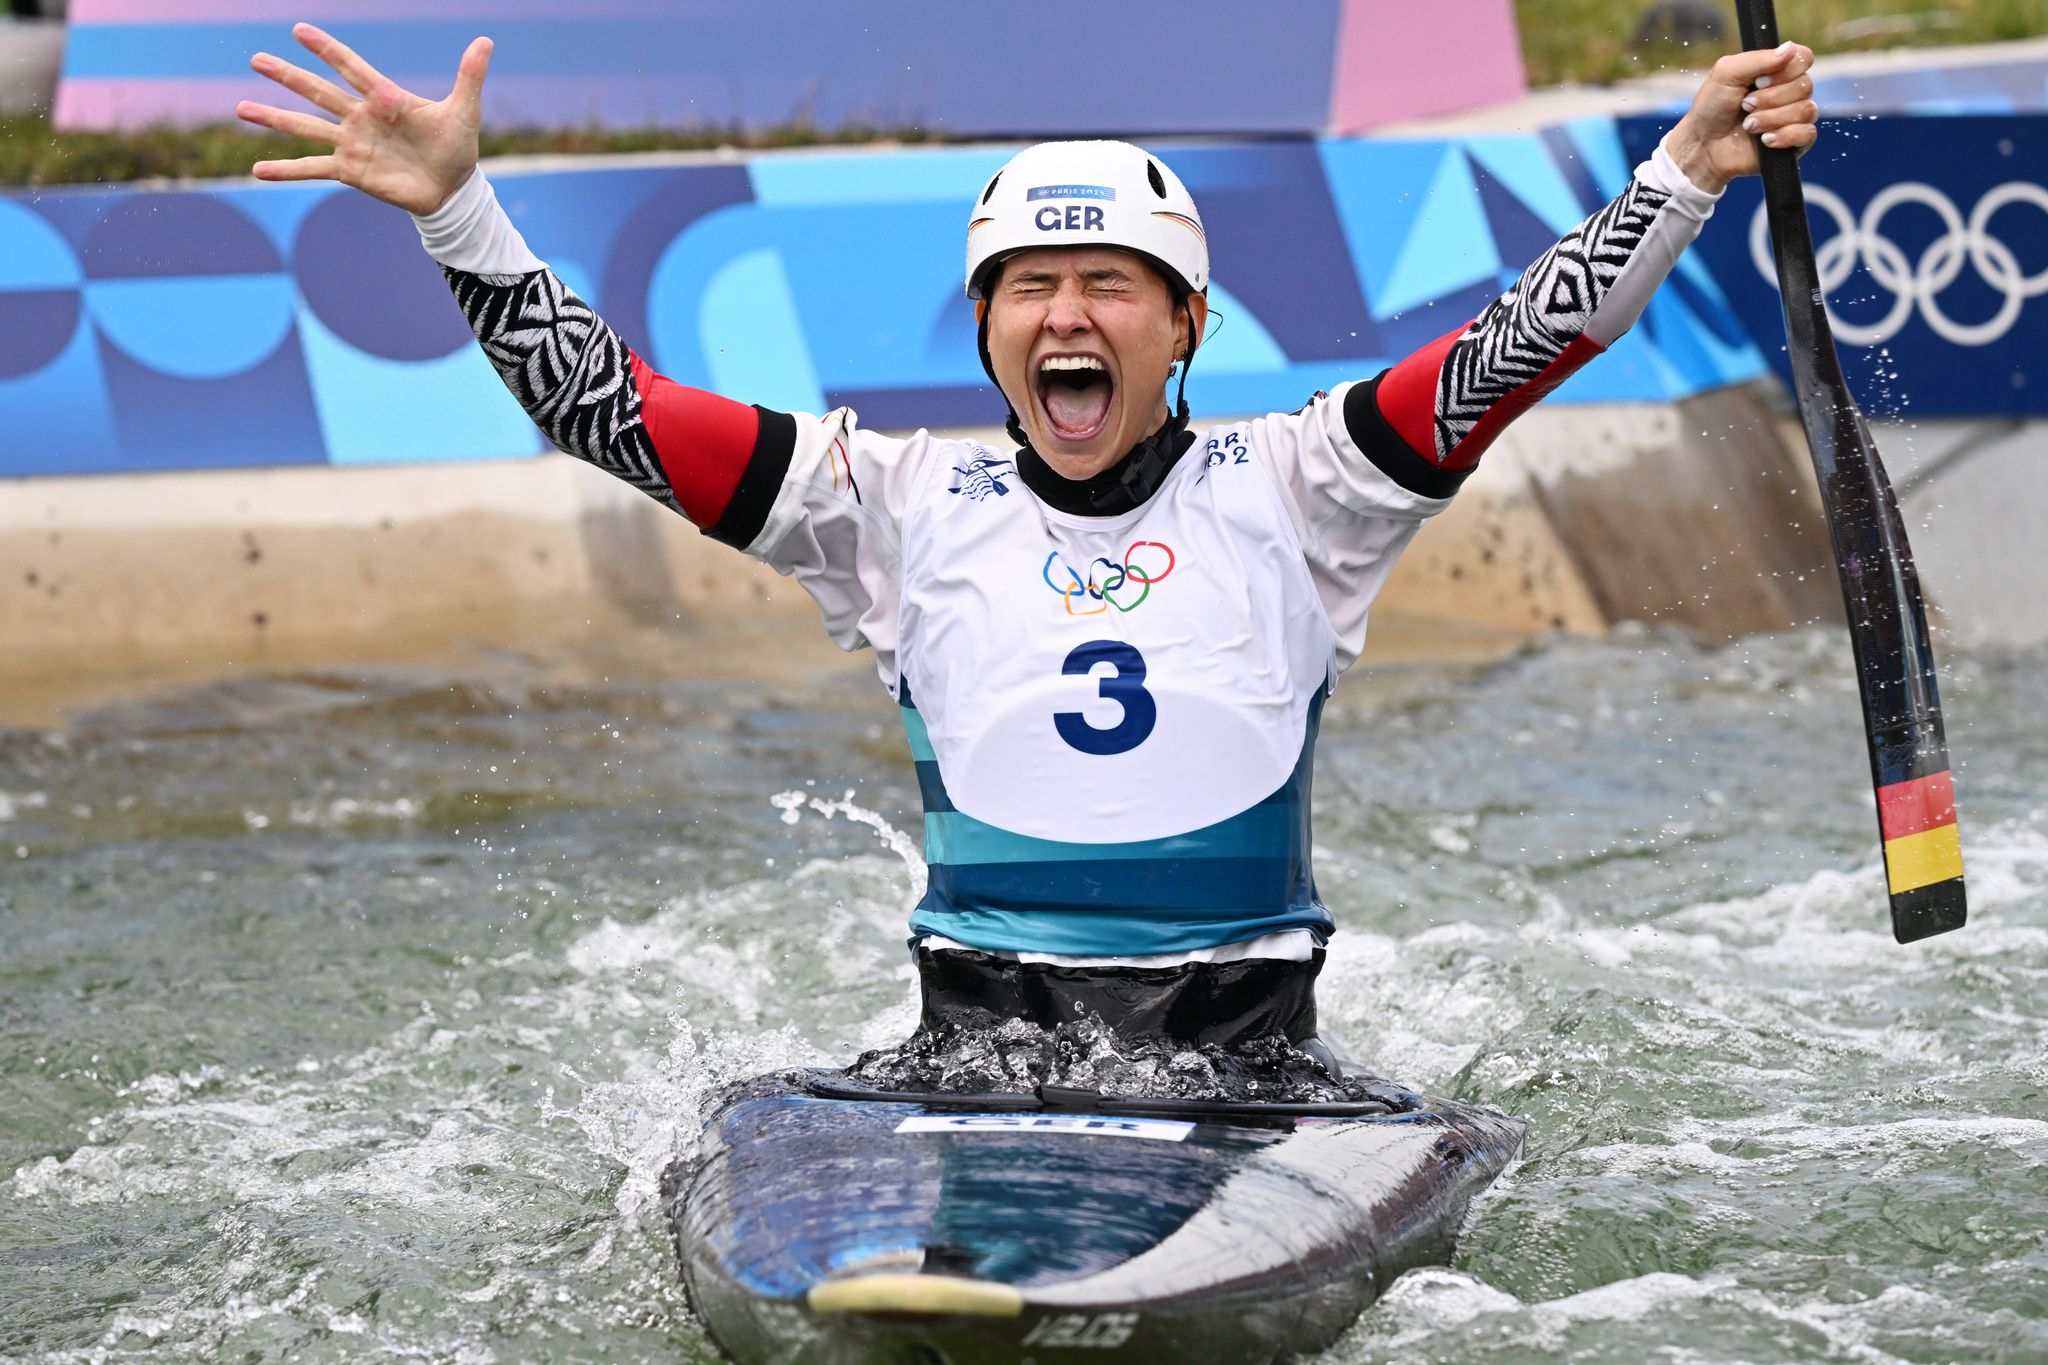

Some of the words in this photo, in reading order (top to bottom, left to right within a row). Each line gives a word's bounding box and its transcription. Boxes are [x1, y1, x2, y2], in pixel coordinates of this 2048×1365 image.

[1080, 188, 1105, 196] 2024
[1034, 205, 1105, 231] GER
[1053, 639, 1157, 756] 3
